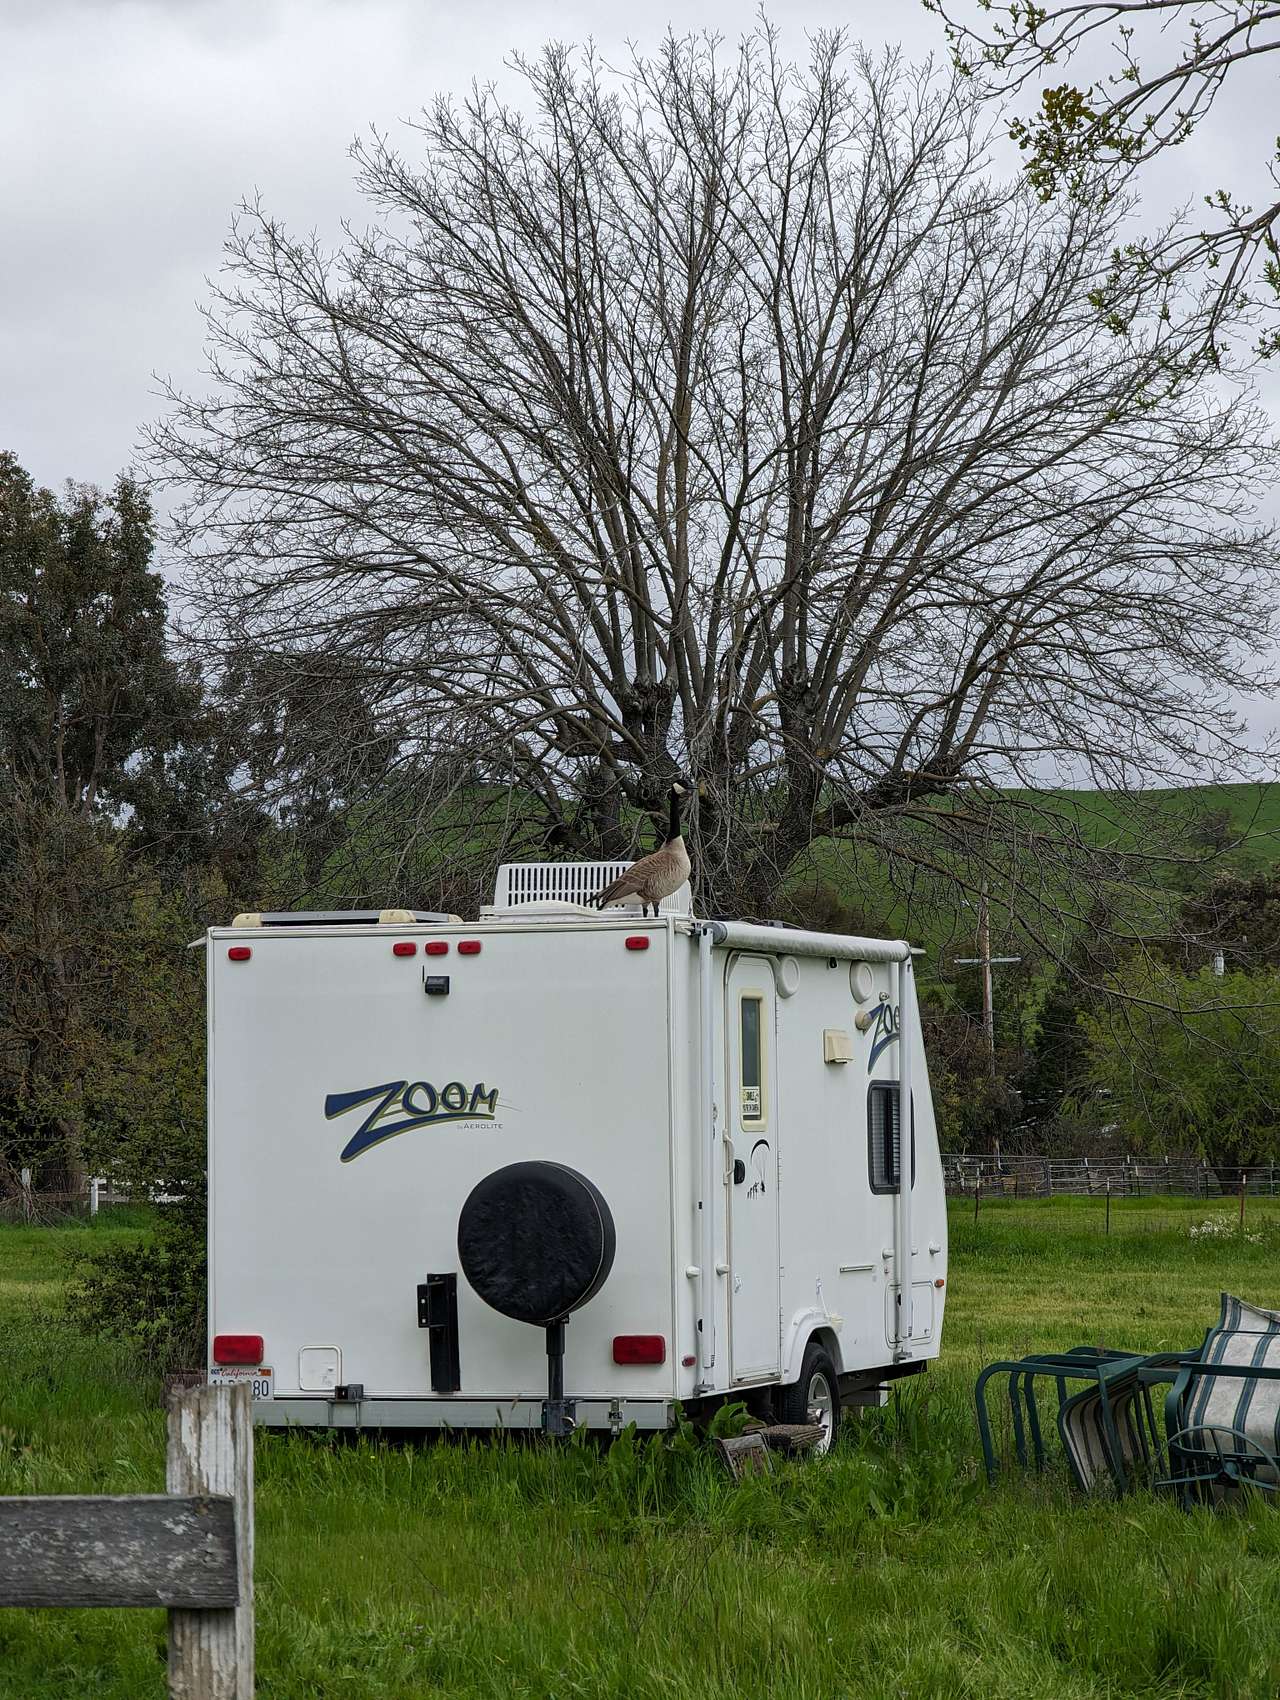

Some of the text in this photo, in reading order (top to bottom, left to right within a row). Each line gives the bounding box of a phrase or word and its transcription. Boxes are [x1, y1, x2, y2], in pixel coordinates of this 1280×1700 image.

[867, 1002, 900, 1075] ZOO
[325, 1080, 499, 1163] ZOOM
[221, 1368, 259, 1379] California
